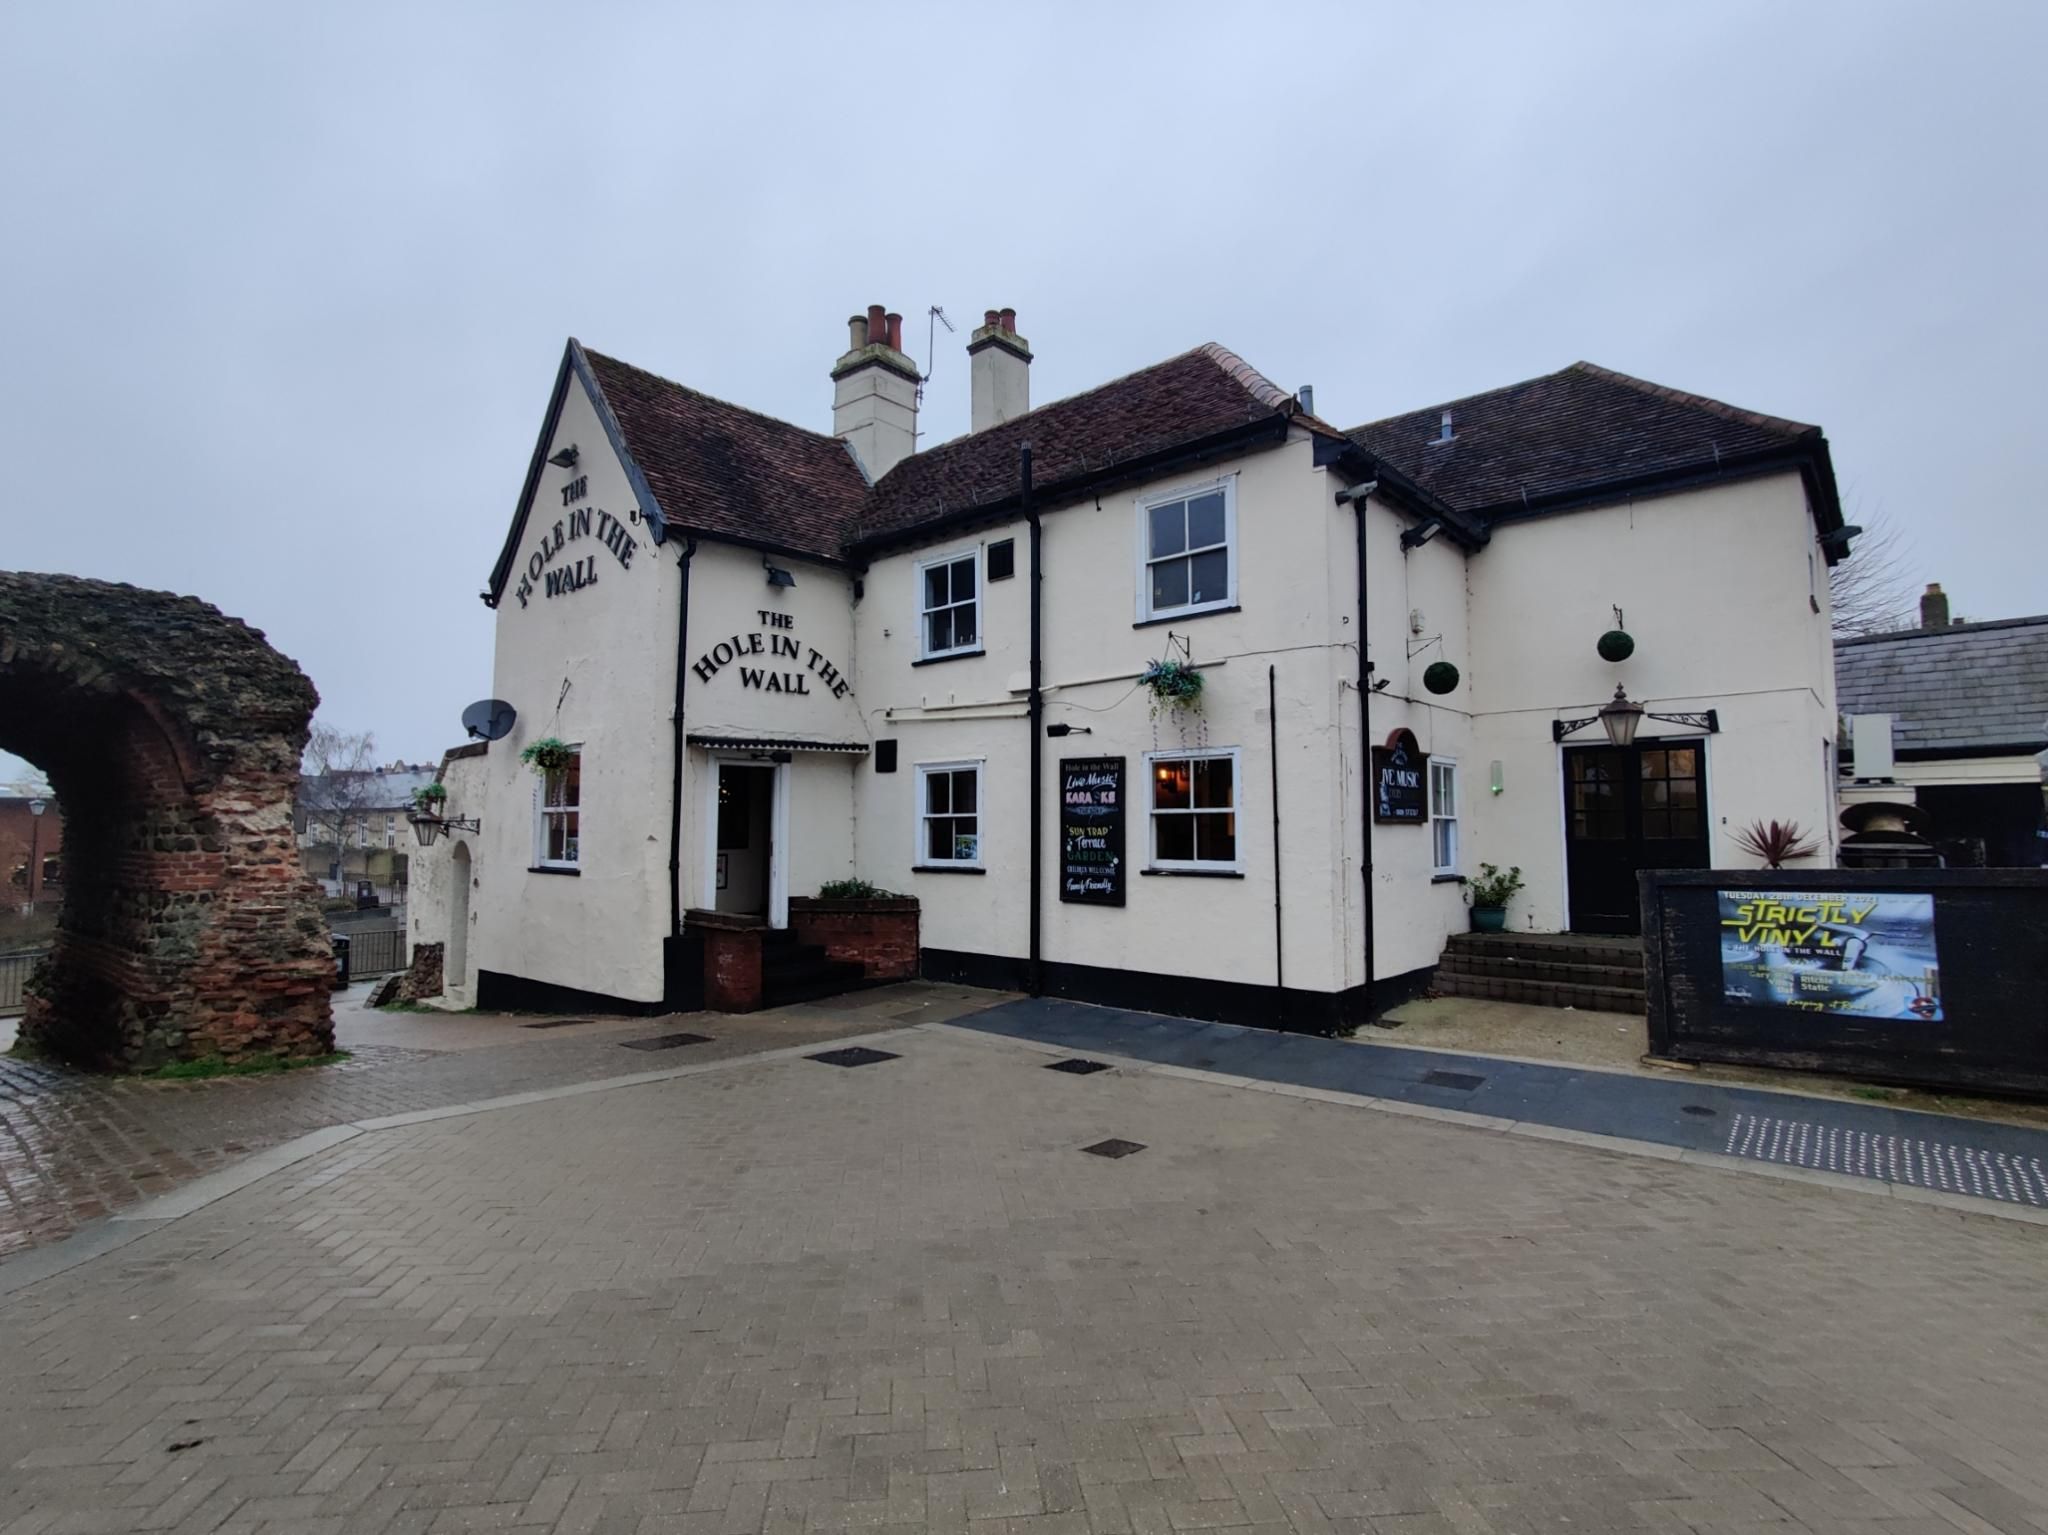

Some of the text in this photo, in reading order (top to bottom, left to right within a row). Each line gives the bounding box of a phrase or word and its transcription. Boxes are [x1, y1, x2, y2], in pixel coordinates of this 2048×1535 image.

[561, 475, 588, 506] THE
[515, 507, 638, 608] HOLE IN THE
[544, 555, 598, 599] WALL
[758, 610, 793, 630] THE
[692, 633, 850, 700] HOLE IN THE
[740, 667, 810, 696] WALL
[1396, 769, 1420, 788] MUSIC
[1069, 826, 1109, 836] SUN TRAP
[1075, 836, 1106, 850] Terrace
[1067, 851, 1114, 862] GARDEN
[1723, 891, 1765, 900] TUESDAY
[1797, 893, 1846, 902] DECEMBER
[1721, 899, 1878, 925] STRICTLY
[1738, 922, 1838, 948] VINYL
[1815, 948, 1841, 956] WALL
